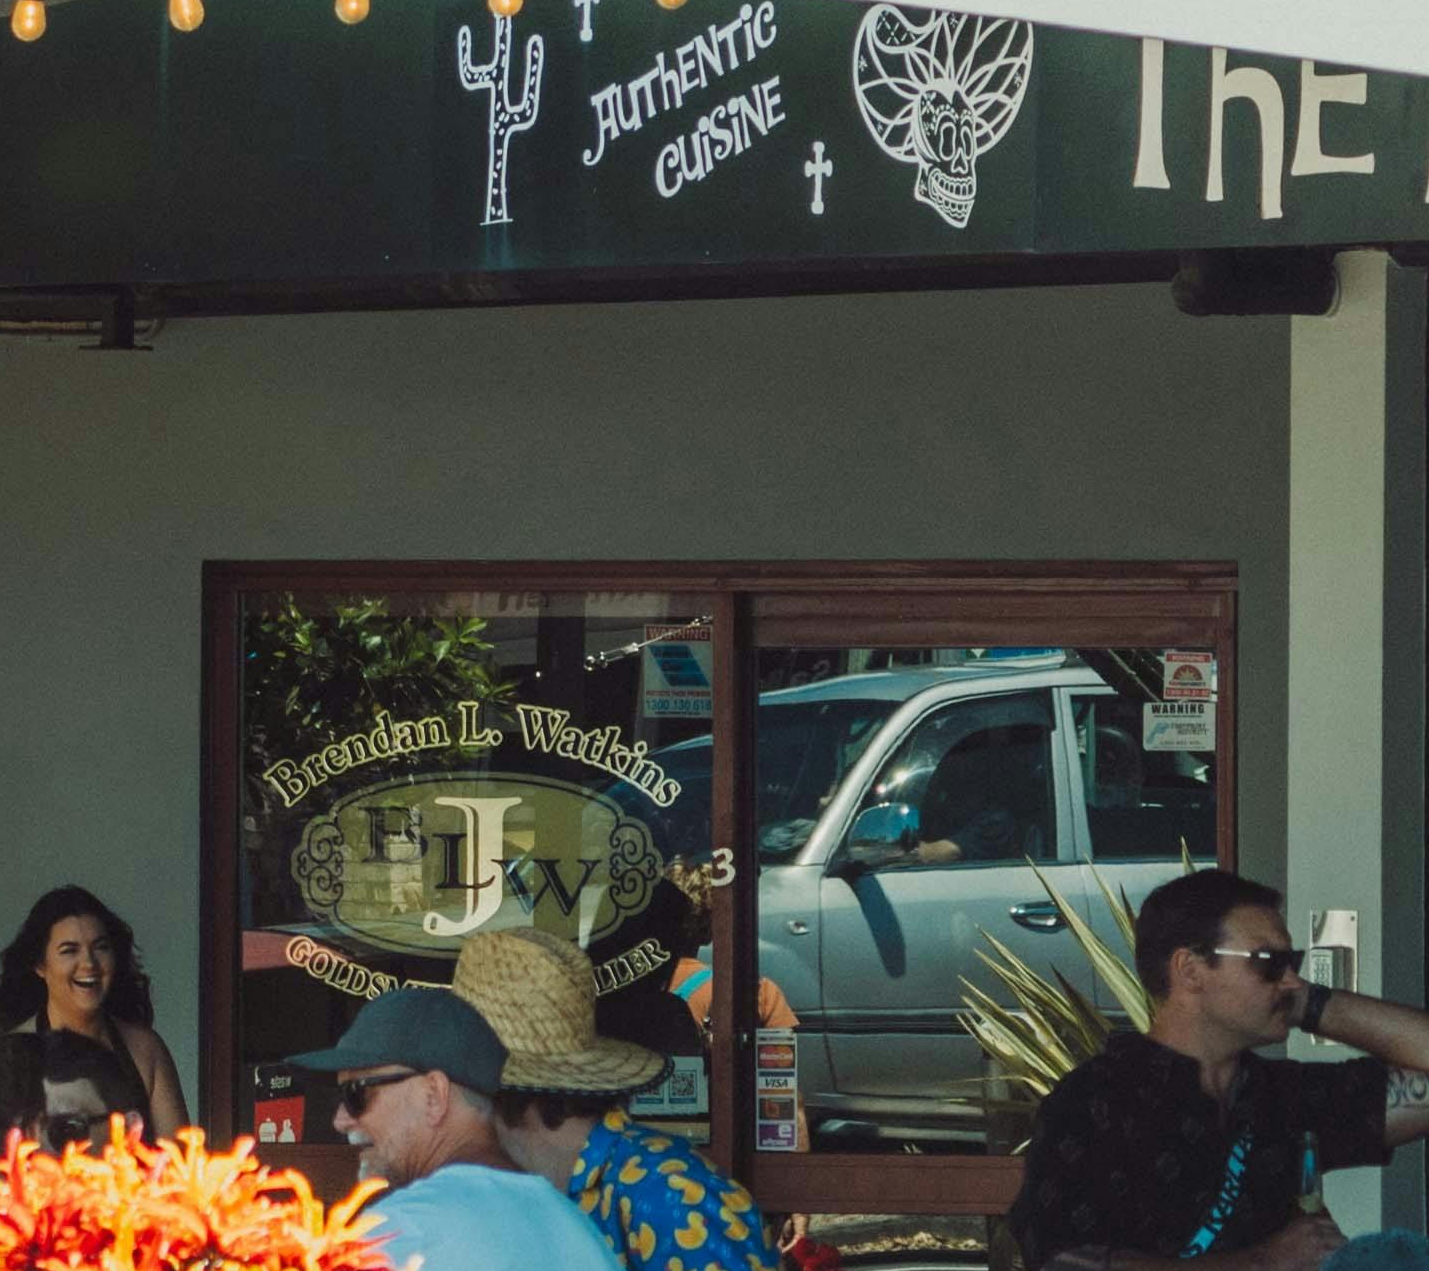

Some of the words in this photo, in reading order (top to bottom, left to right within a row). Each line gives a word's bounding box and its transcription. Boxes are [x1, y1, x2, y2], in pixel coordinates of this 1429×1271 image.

[1151, 704, 1205, 715] WARNING
[264, 711, 450, 807] Brendan
[516, 702, 682, 807] Watkins
[710, 847, 736, 887] 3
[765, 1078, 789, 1088] VISA
